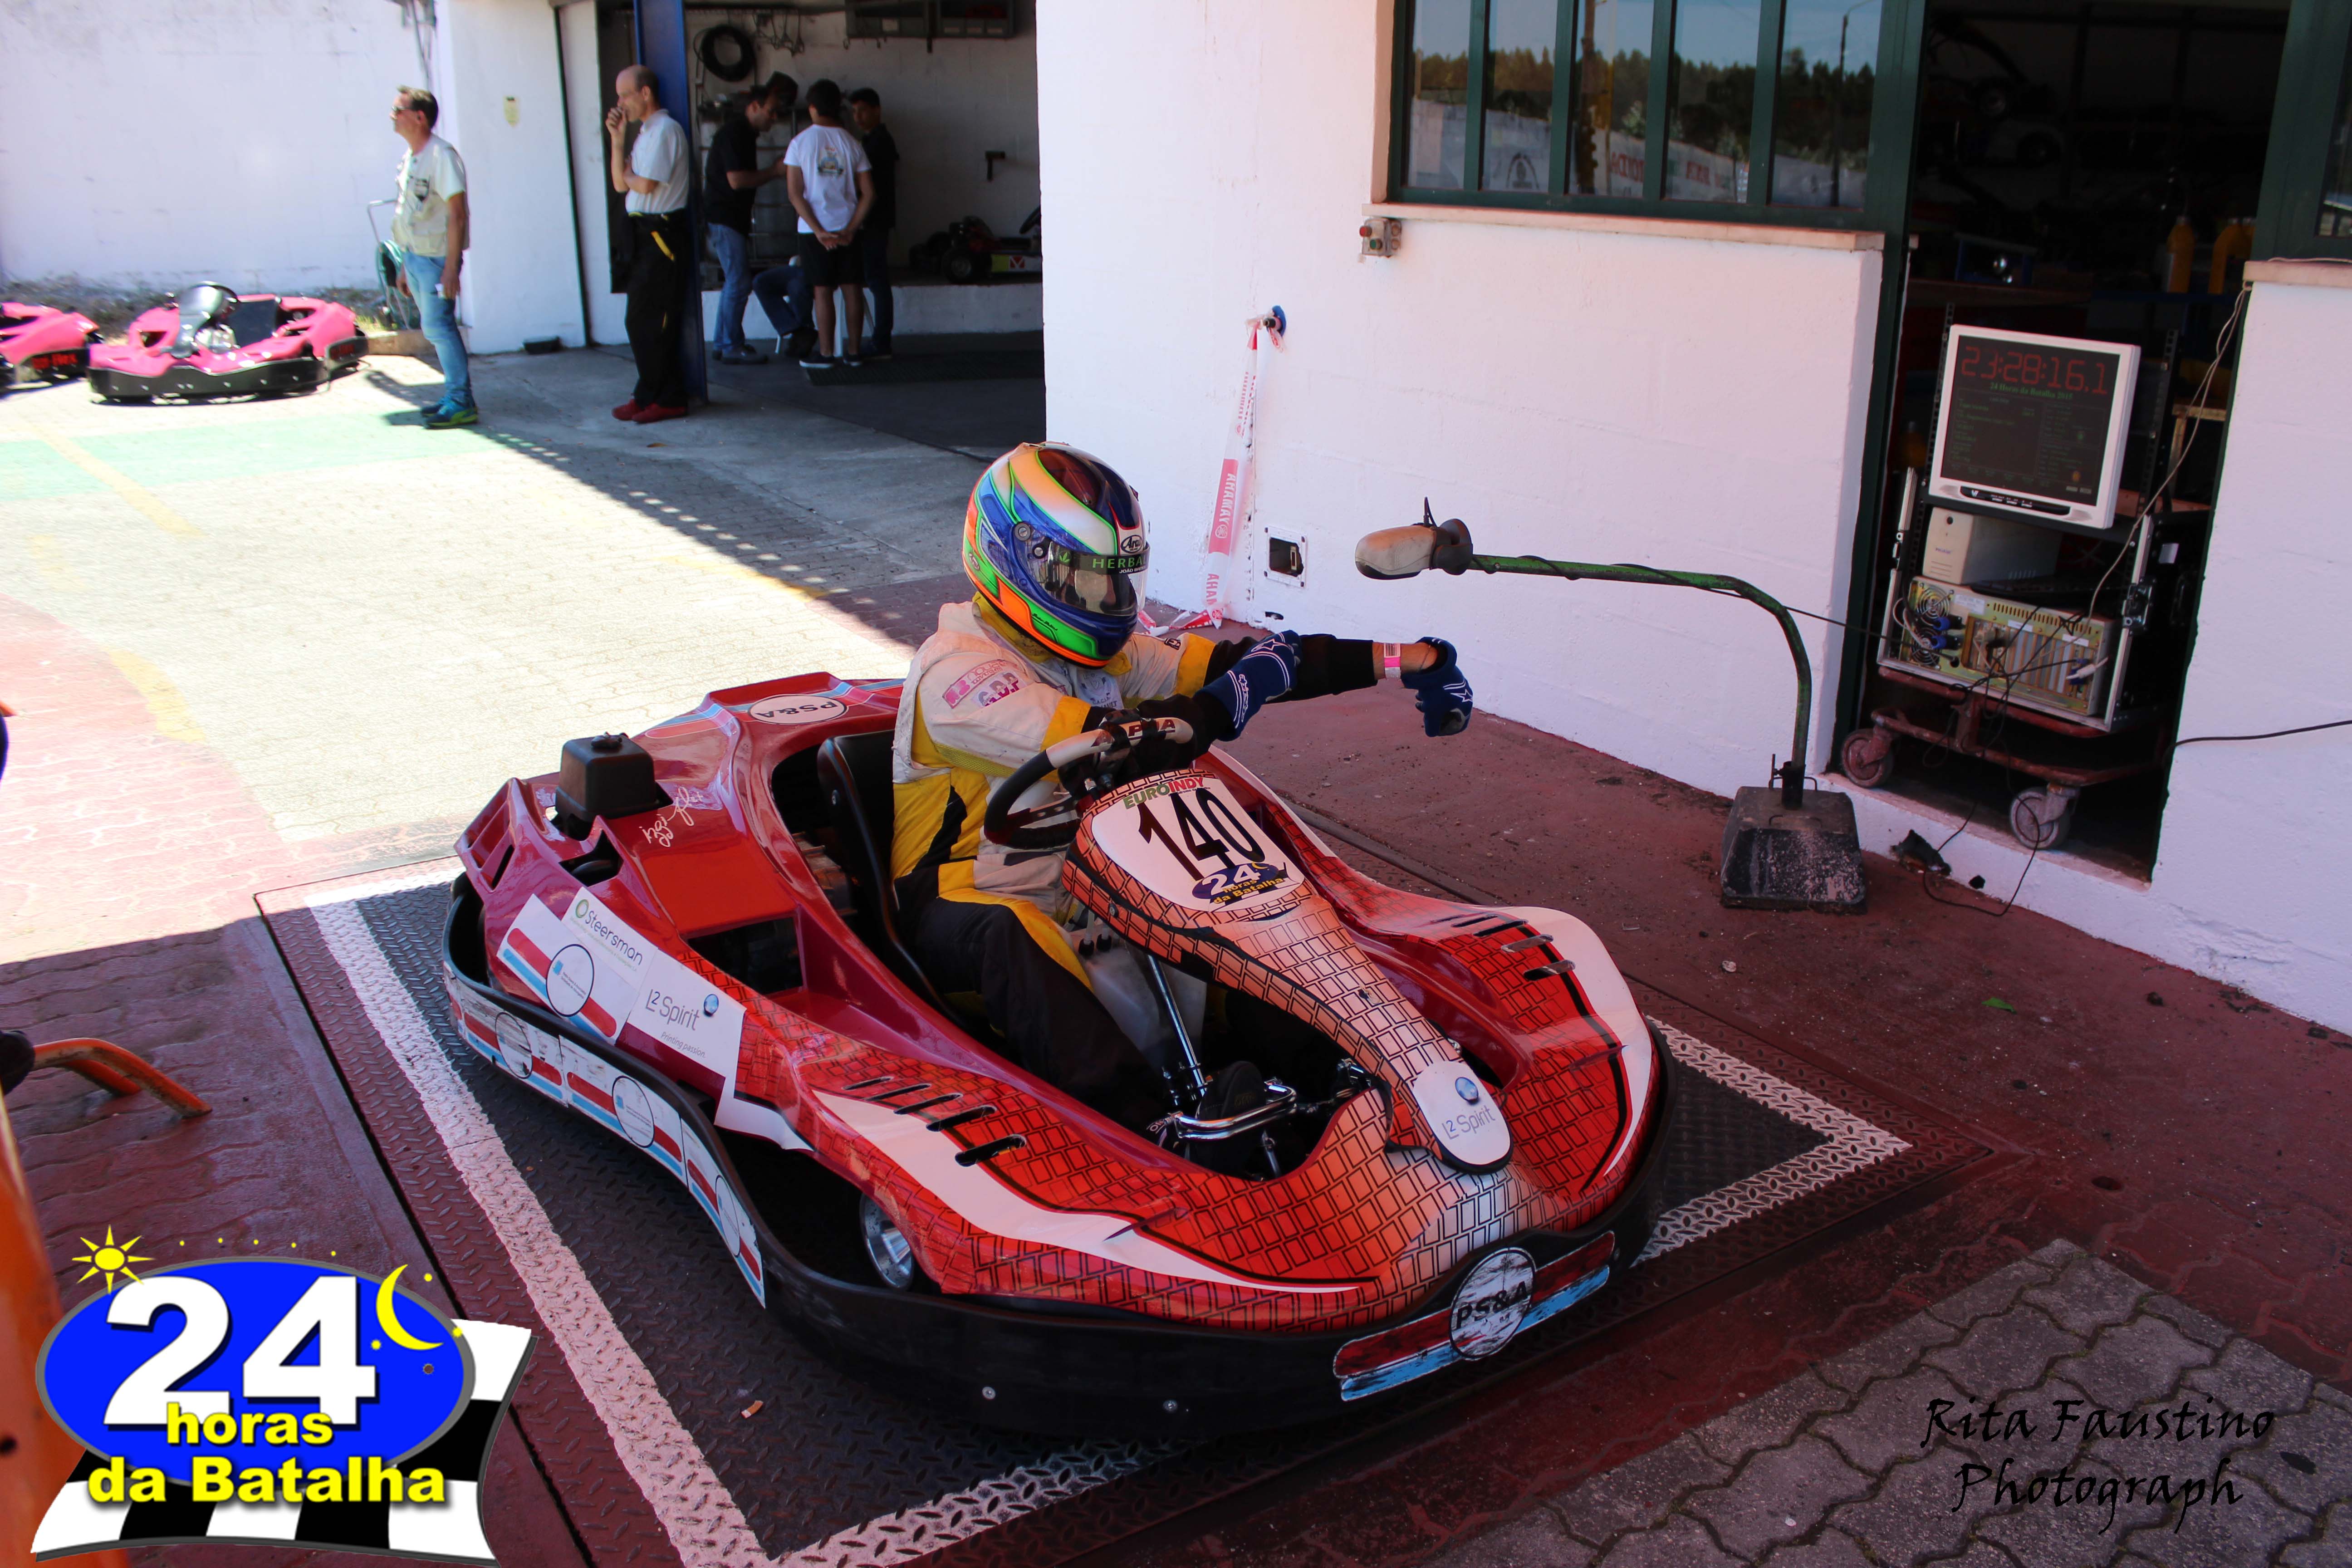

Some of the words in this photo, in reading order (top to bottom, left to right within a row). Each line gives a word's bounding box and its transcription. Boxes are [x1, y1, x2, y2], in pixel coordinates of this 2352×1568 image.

[1961, 346, 2107, 395] 23:28:16.1
[755, 701, 838, 718] PS&A
[1138, 788, 1265, 881] 140
[1202, 864, 1261, 896] 24
[1213, 896, 1231, 904] da
[1232, 877, 1285, 897] Batalha
[1223, 879, 1257, 893] horas
[585, 910, 643, 966] Steersman
[659, 996, 700, 1031] Spirit
[661, 1031, 684, 1049] Printing
[1456, 1105, 1496, 1134] Spirit
[1455, 1281, 1529, 1330] PS&A
